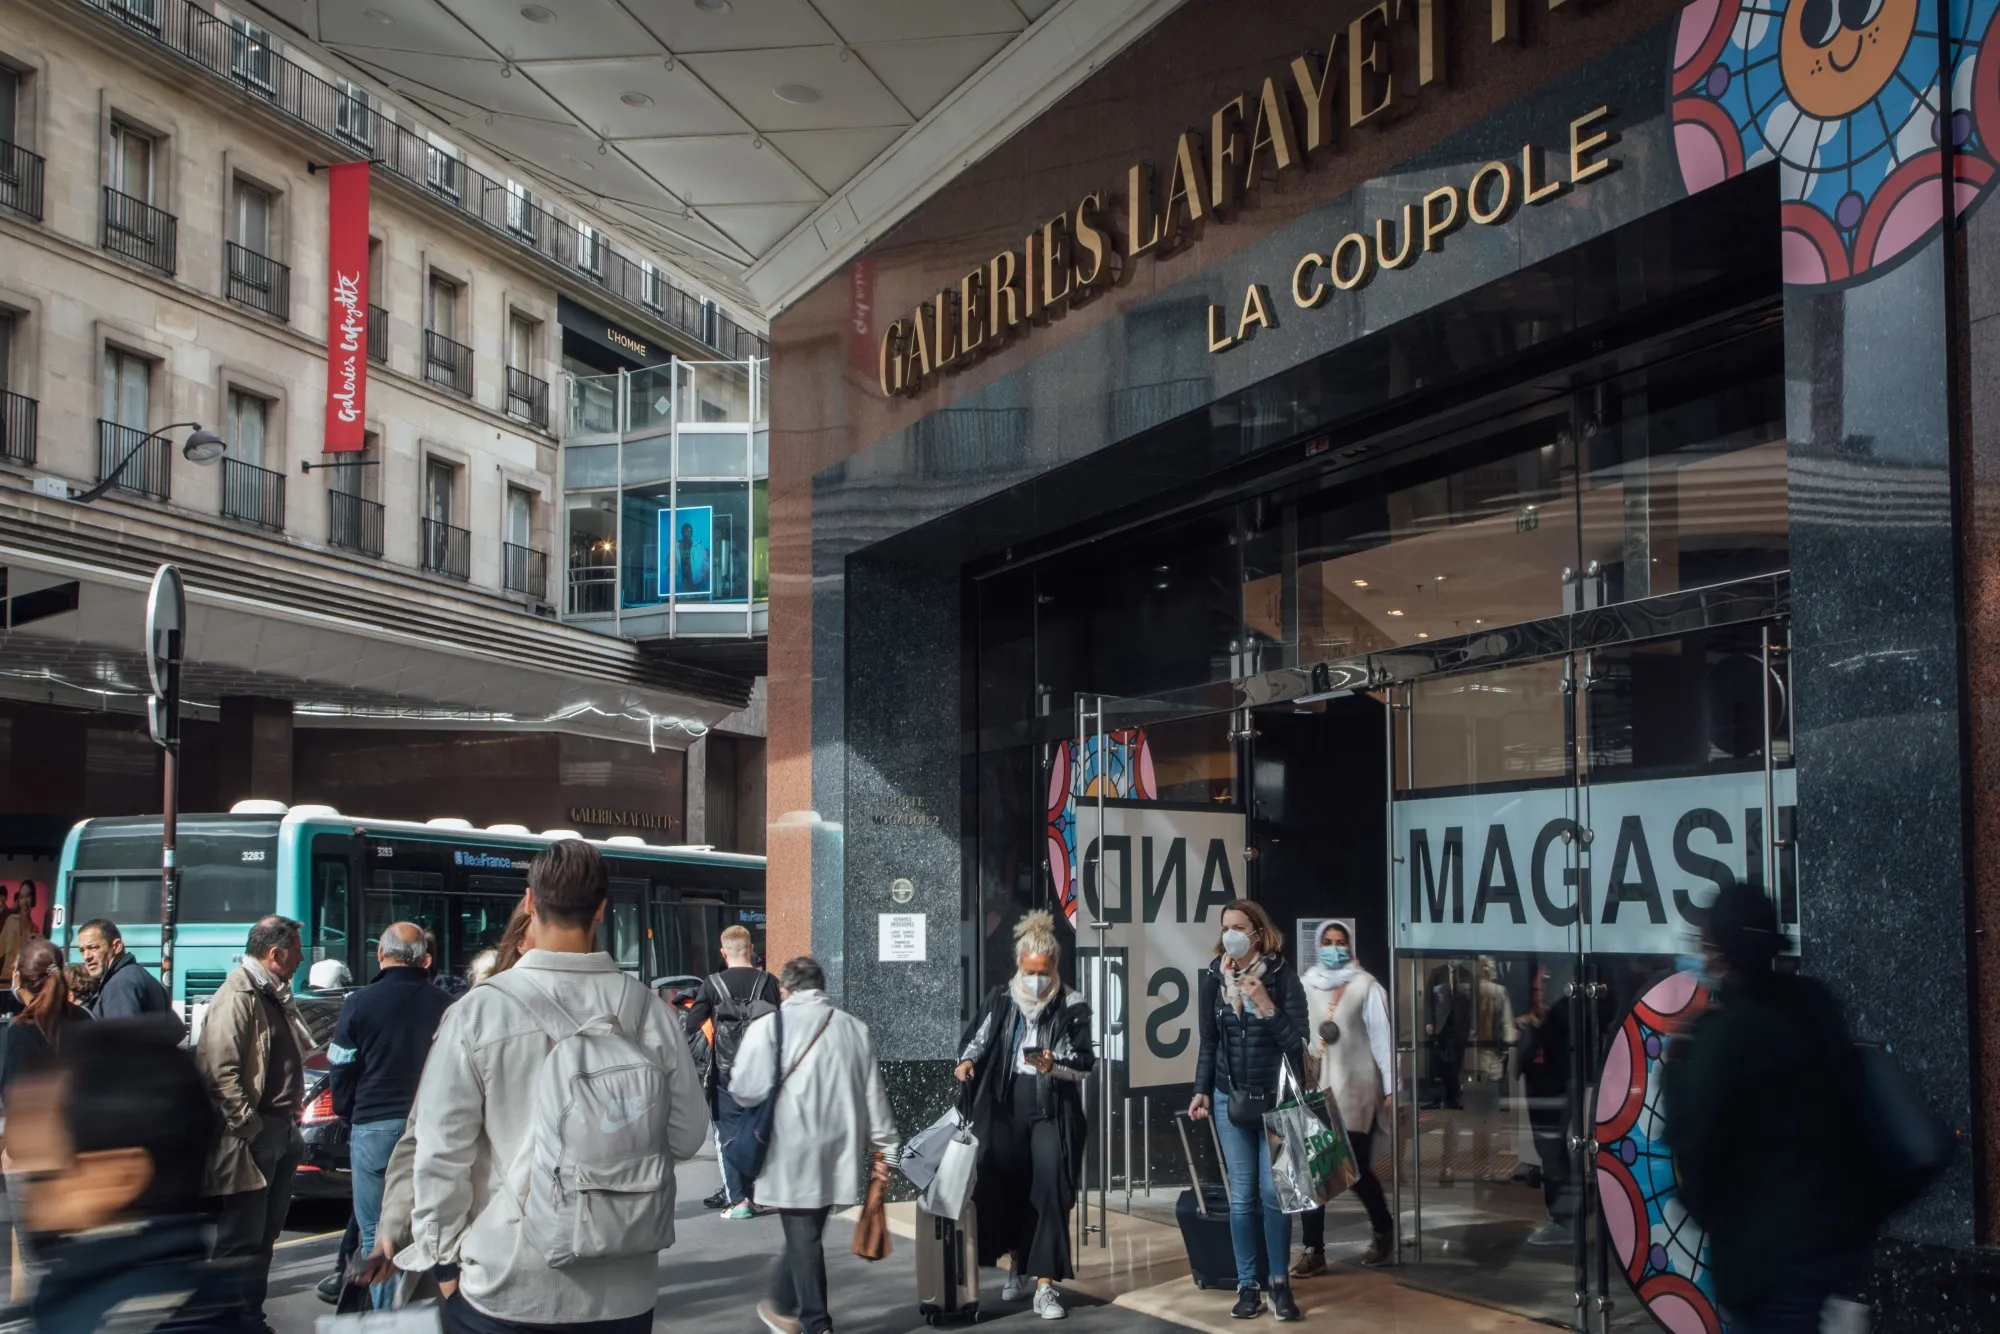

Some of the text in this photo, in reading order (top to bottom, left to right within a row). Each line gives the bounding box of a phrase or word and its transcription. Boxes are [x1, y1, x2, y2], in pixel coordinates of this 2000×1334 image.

[879, 0, 1570, 397] GALERIES LAFAYET
[1208, 105, 1609, 354] LA COUPOLE
[333, 270, 364, 422] Galeries Lafayette
[607, 328, 646, 357] L'HOMME
[887, 796, 925, 808] PORTE
[932, 814, 940, 826] 2
[241, 851, 265, 861] 3283
[376, 846, 394, 857] 3283
[1409, 804, 1798, 928] MAGASI
